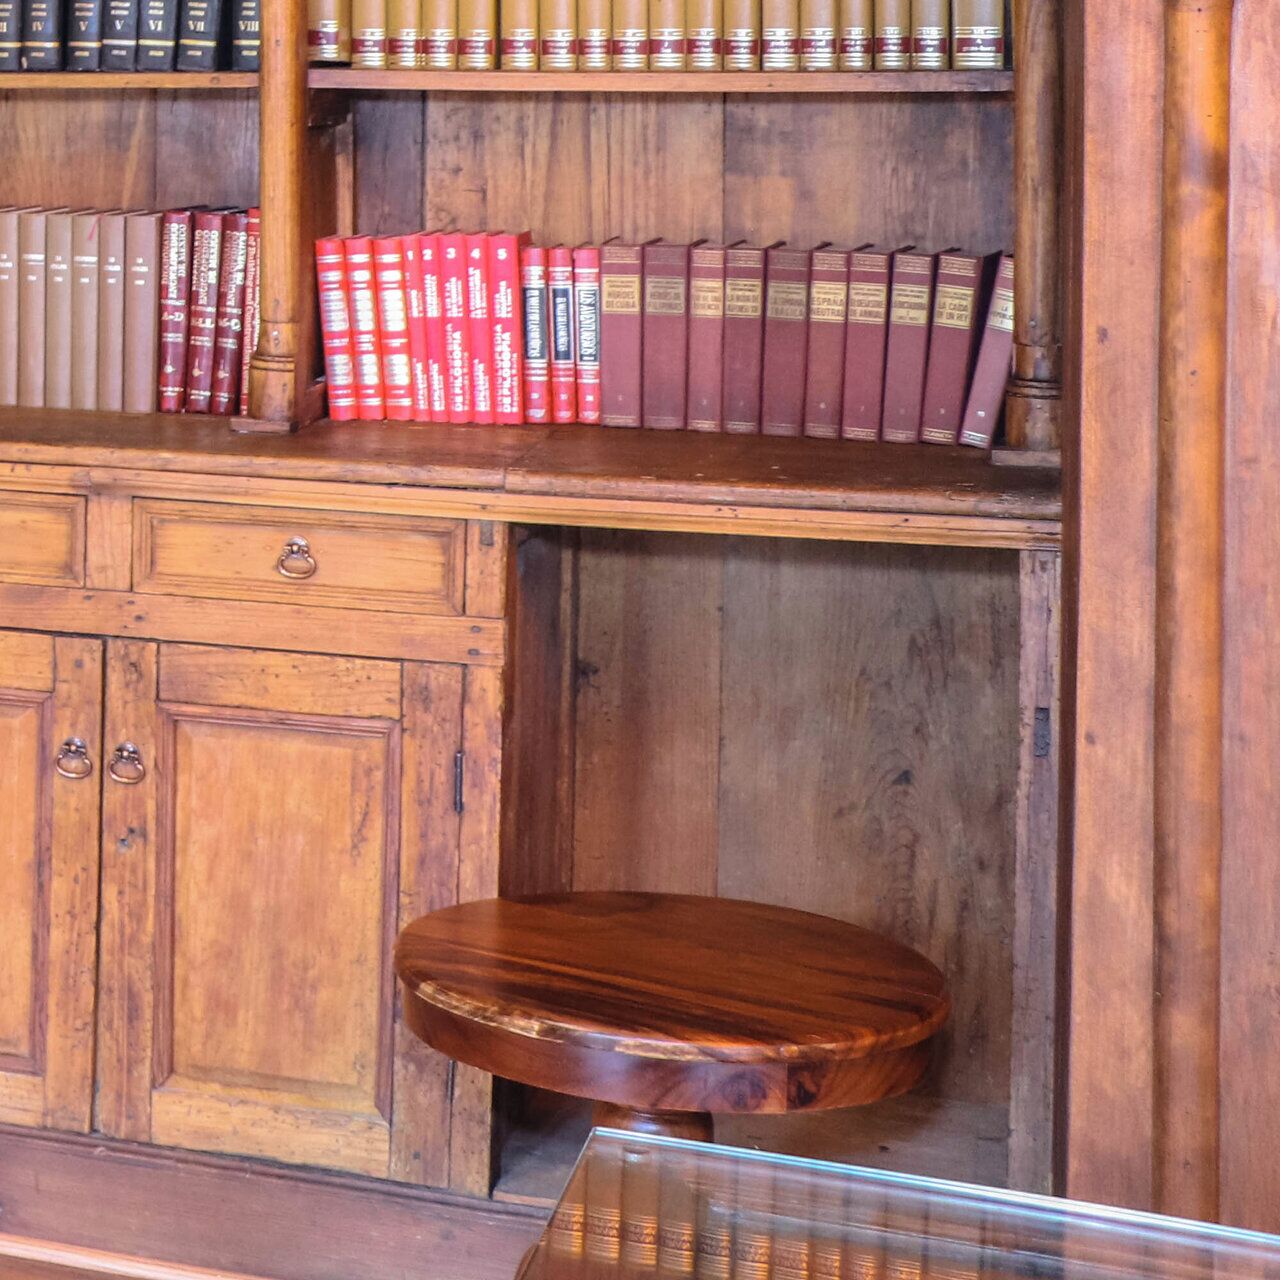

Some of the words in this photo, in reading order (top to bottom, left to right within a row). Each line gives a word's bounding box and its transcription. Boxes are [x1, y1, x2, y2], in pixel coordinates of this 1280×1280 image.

[406, 250, 414, 261] 1
[422, 249, 433, 260] 2
[446, 247, 456, 259] 3
[470, 247, 481, 259] 4
[497, 248, 507, 260] 5
[246, 243, 256, 287] Building
[246, 288, 255, 304] and
